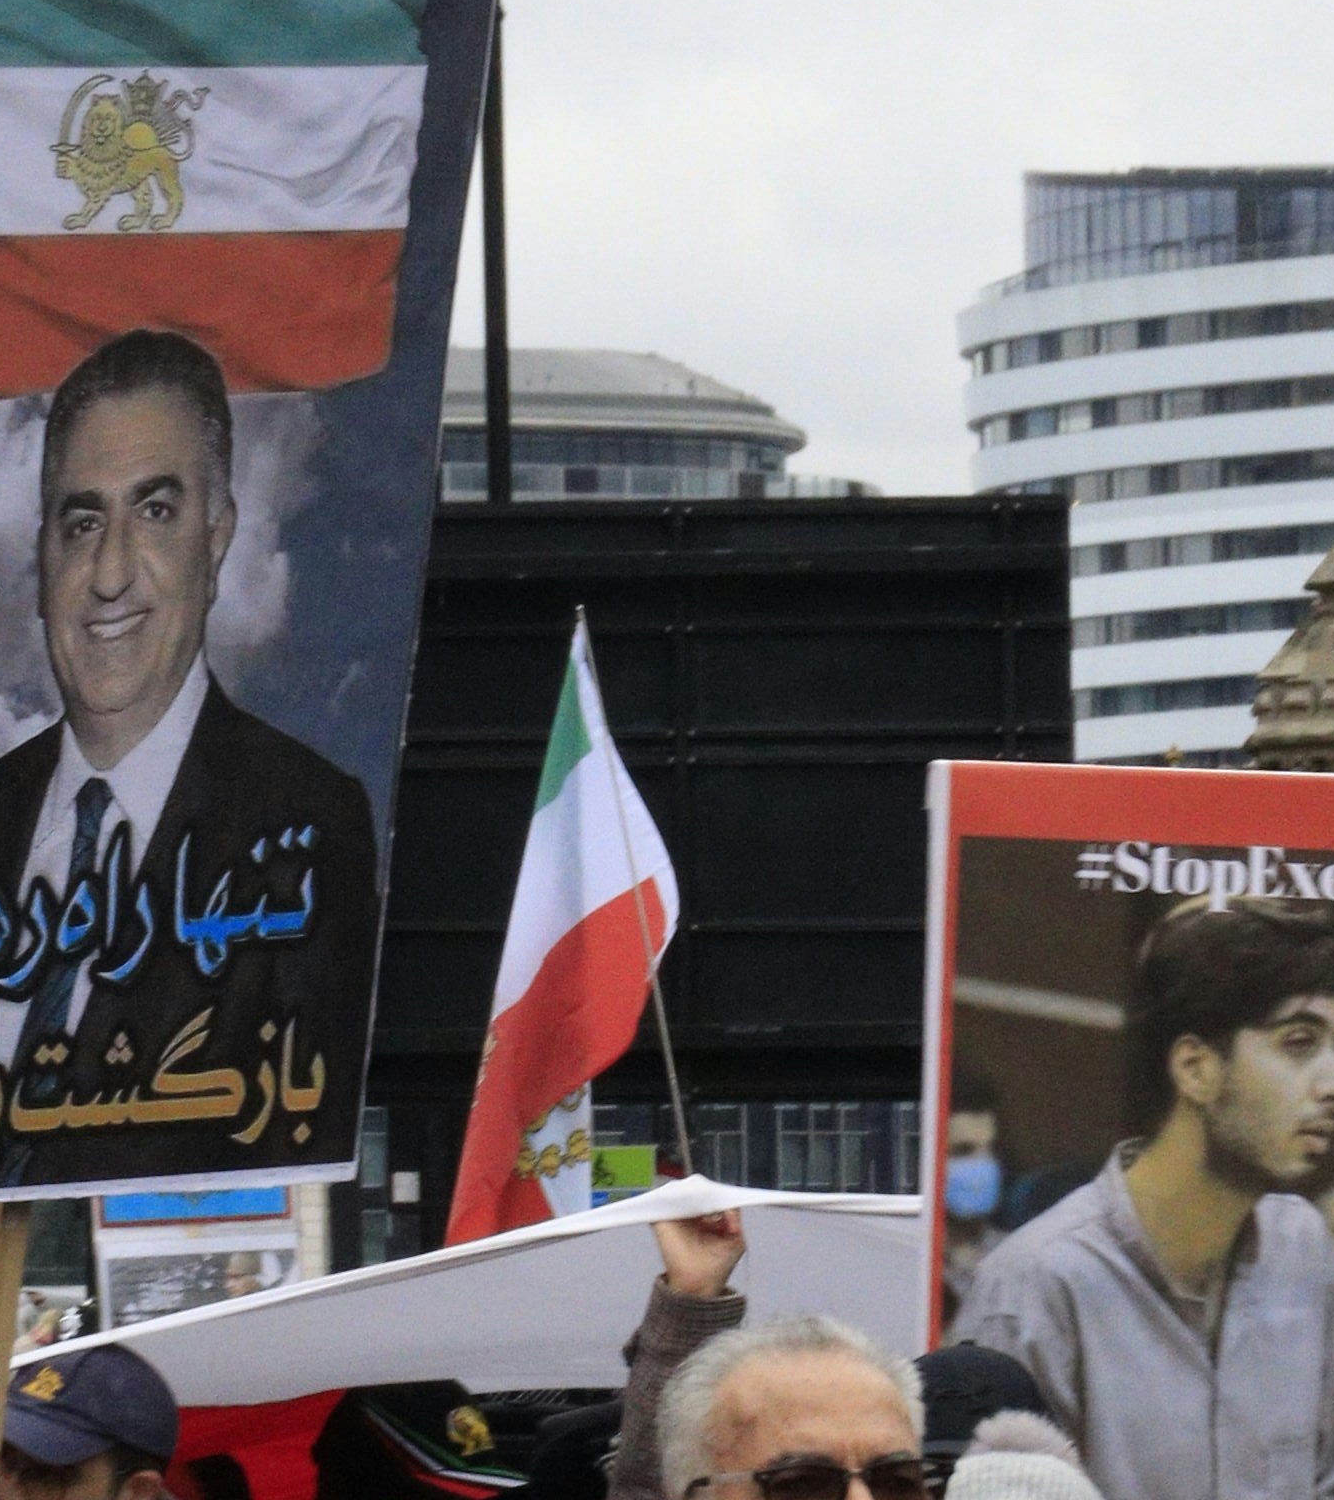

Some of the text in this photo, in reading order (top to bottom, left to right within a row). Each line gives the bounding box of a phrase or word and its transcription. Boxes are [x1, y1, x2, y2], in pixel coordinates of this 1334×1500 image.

[56, 826, 154, 983] راه
[177, 825, 314, 978] تنها
[9, 1006, 326, 1146] بازگشت
